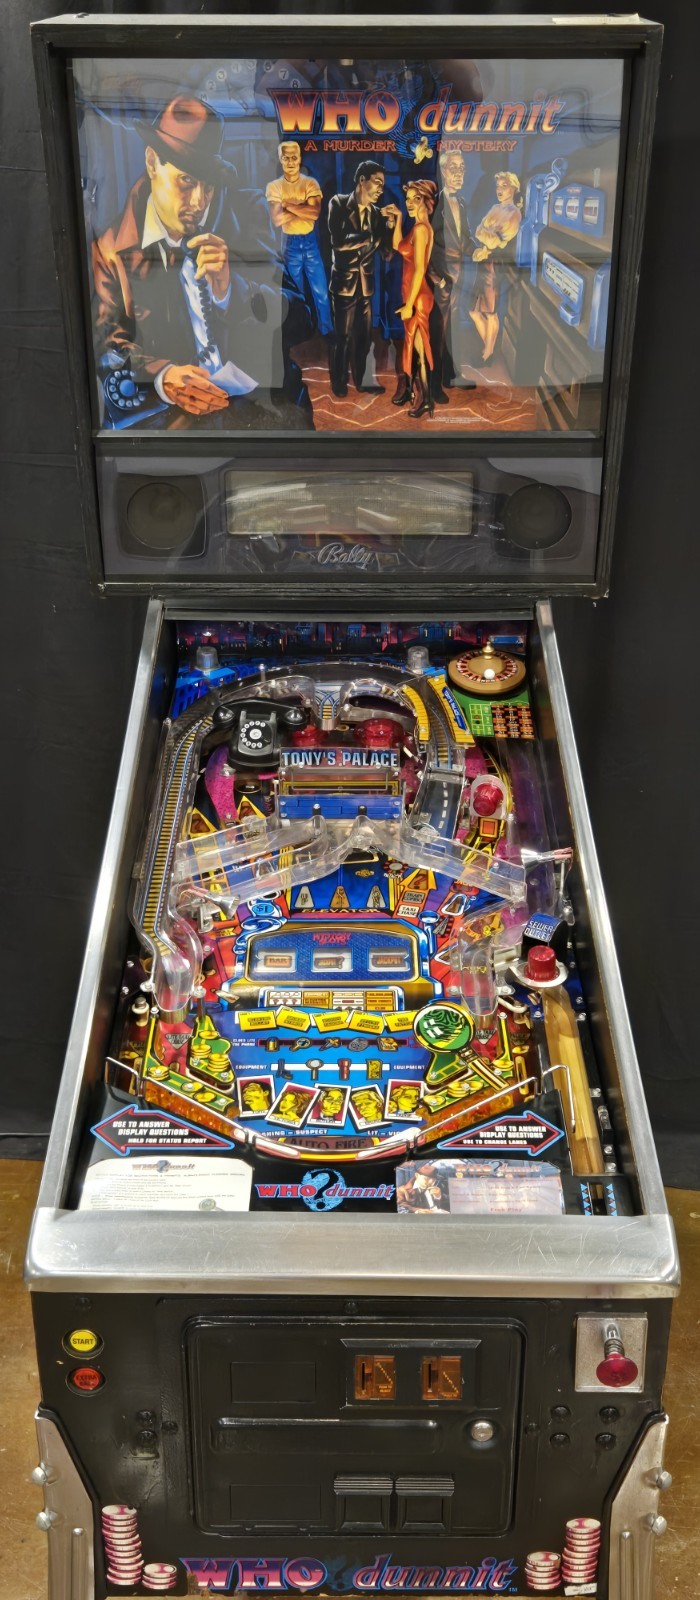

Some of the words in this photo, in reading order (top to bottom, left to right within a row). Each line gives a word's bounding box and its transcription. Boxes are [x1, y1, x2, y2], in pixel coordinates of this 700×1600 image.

[279, 70, 287, 79] 7
[292, 79, 299, 89] 8
[269, 88, 402, 135] WHO
[418, 84, 567, 135] dunnit
[304, 140, 318, 152] A
[323, 140, 397, 153] MURDER
[436, 140, 518, 152] MYSTERY
[317, 542, 373, 570] Bally
[281, 751, 337, 766] TONY'S
[342, 751, 399, 767] PALACE
[529, 920, 554, 932] SEWER
[524, 928, 551, 941] OUTLET
[289, 1137, 332, 1149] AUTO
[335, 1138, 368, 1149] FIRE
[254, 1184, 317, 1198] WHO
[325, 1183, 396, 1198] dunnit
[179, 1556, 328, 1591] WHO
[352, 1553, 518, 1591] dunnit
